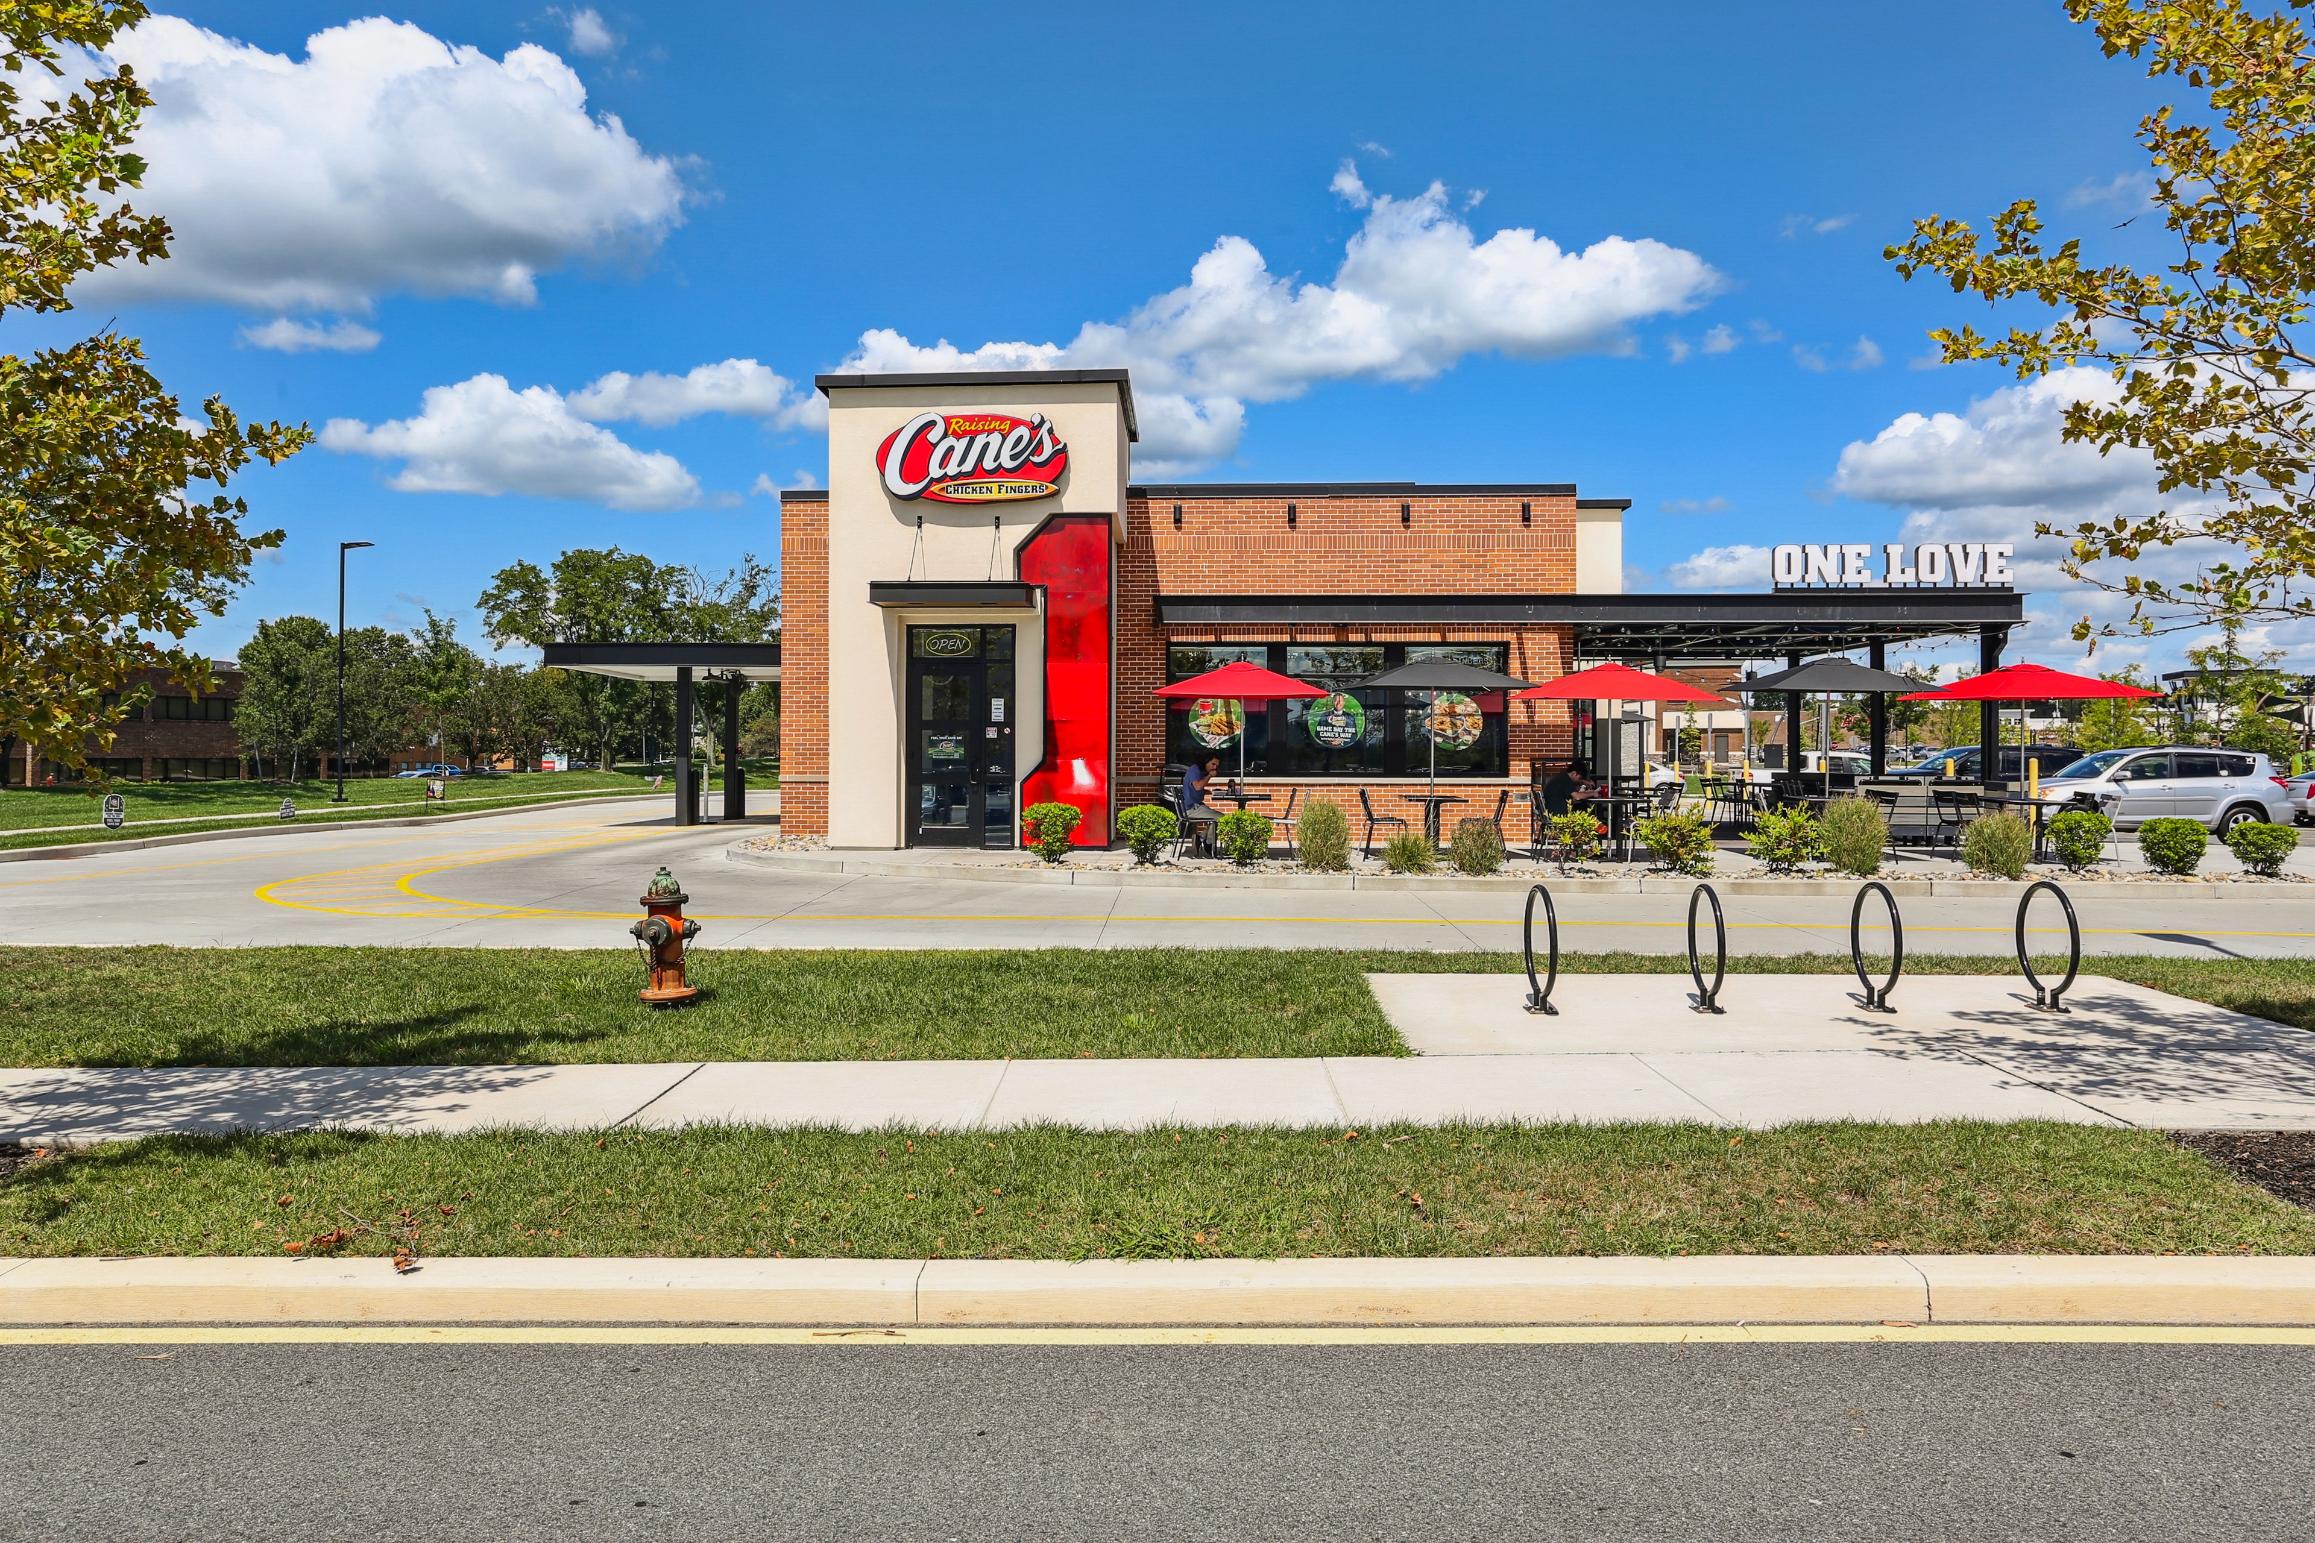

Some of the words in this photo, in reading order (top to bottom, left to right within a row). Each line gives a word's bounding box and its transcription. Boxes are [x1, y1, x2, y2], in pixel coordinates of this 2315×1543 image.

[948, 416, 1011, 436] Raising
[884, 412, 1068, 498] Cane's
[1771, 543, 1872, 584] ONE
[1882, 543, 2015, 584] LOVE
[930, 639, 965, 650] OPEN
